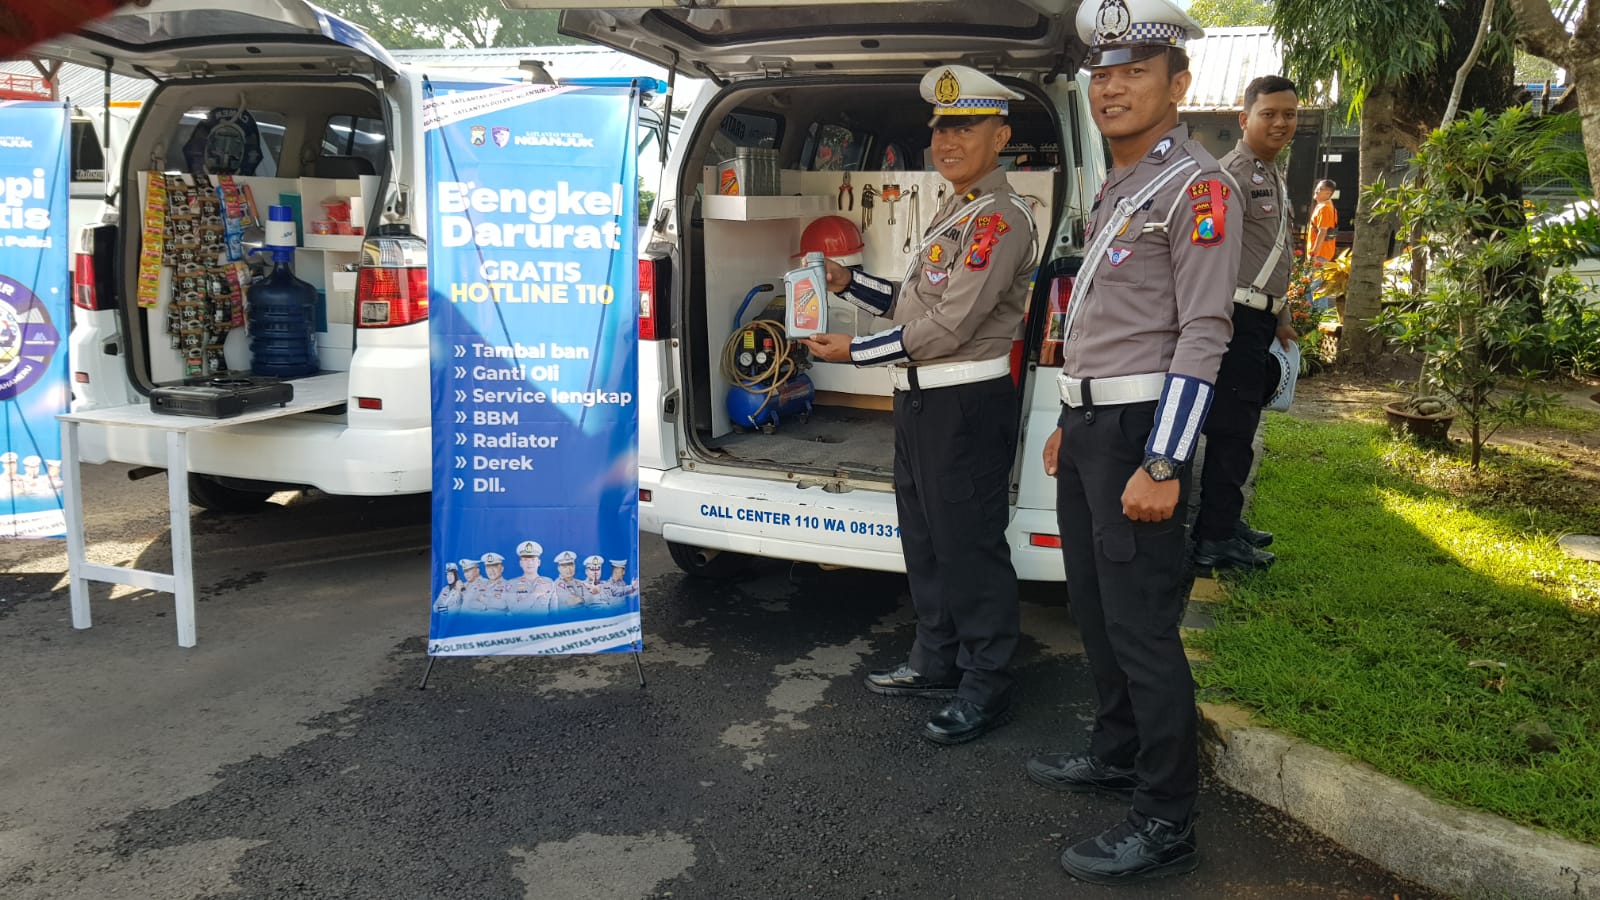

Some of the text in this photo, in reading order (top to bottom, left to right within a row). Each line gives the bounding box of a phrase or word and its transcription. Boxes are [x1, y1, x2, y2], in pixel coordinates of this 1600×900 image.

[514, 135, 594, 148] NGANJUK
[0, 168, 45, 208] pi
[438, 181, 623, 224] Bengkel
[441, 216, 622, 250] Darurat
[479, 259, 582, 283] GRATIS
[451, 282, 615, 305] HOTLINE 110
[472, 343, 589, 360] Tambal ban
[472, 365, 560, 382] Ganti Oli
[472, 387, 632, 407] Service lengkap
[473, 411, 519, 425] BBM
[473, 432, 558, 448] Radiator
[473, 456, 534, 471] Derek
[473, 477, 506, 493] Dll.
[700, 504, 901, 539] CALL CENTER 110 WA 081331
[476, 636, 522, 648] NGANJUK
[528, 627, 584, 641] SATLANTAS
[592, 630, 627, 645] POLRES
